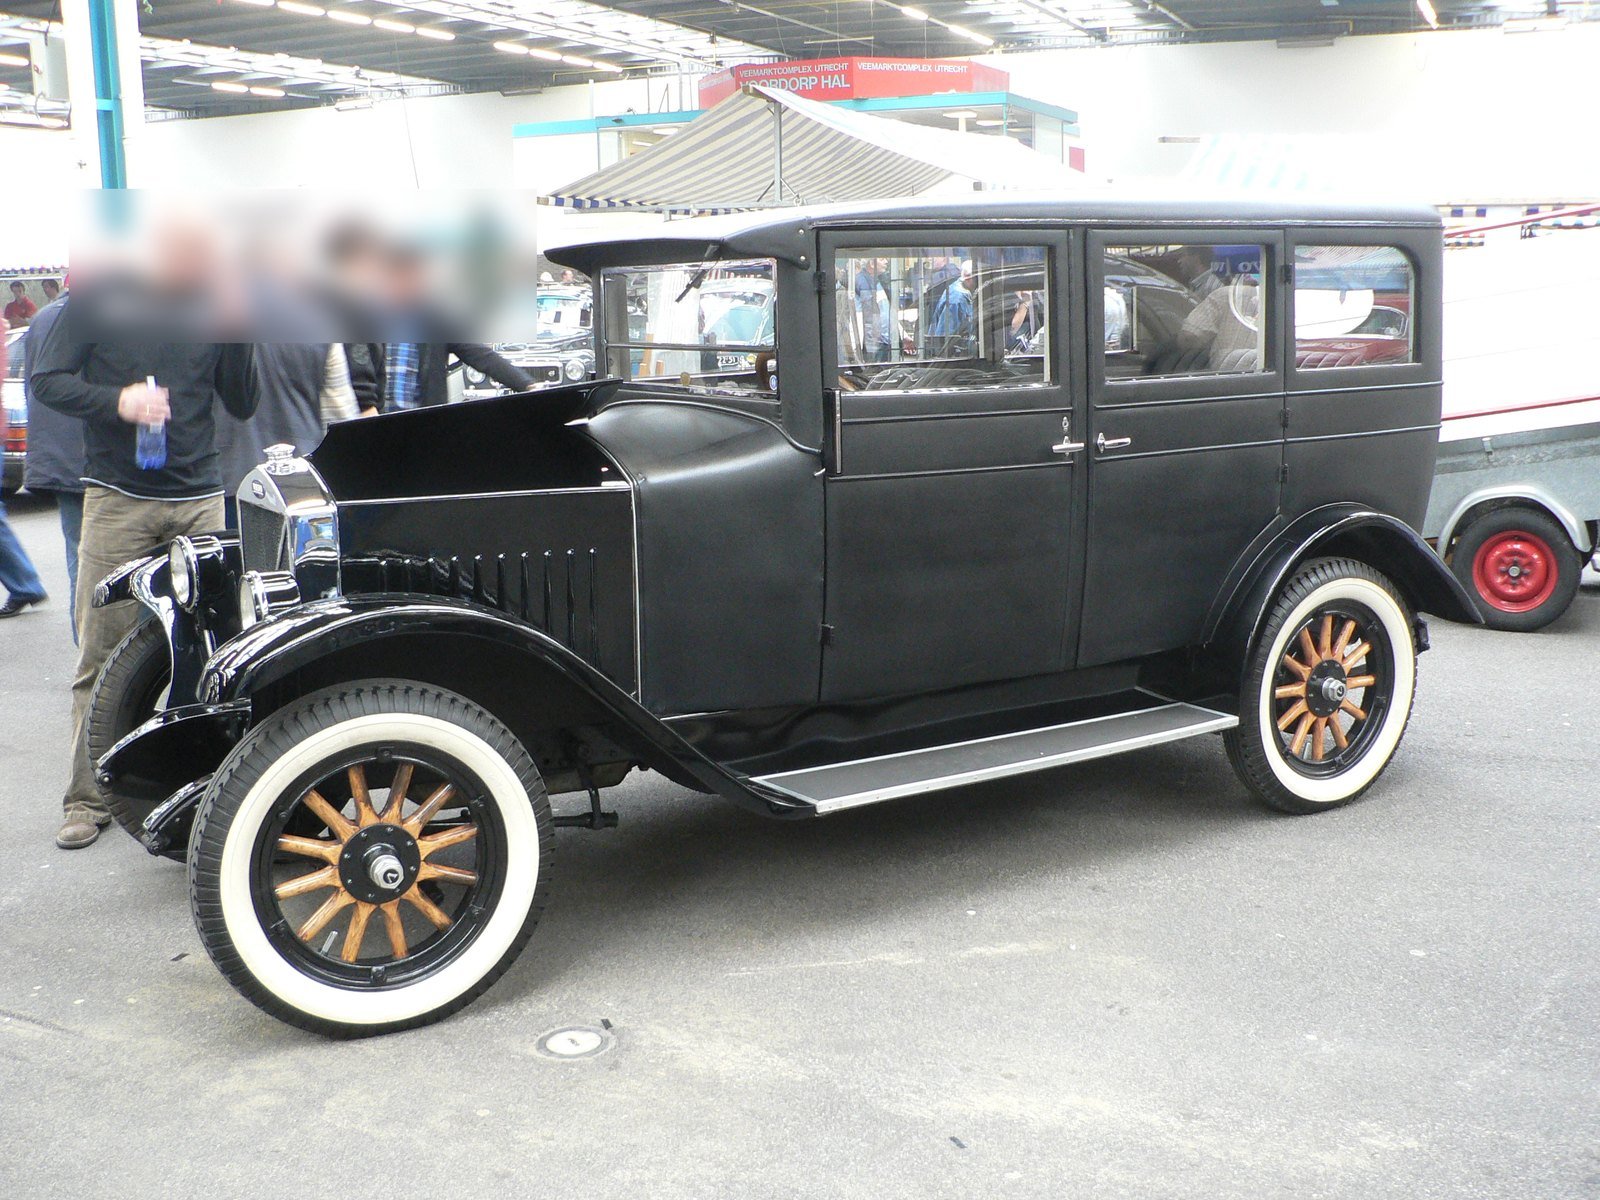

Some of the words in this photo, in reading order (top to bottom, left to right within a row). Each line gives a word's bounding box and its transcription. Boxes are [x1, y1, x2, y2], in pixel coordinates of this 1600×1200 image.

[740, 65, 812, 78] VEEMARKTCOMPLEX
[814, 62, 849, 73] UTRECHT
[857, 62, 933, 73] VEEMARKTCOMPLEX
[934, 65, 969, 73] UTRECHT
[821, 74, 851, 89] HAL
